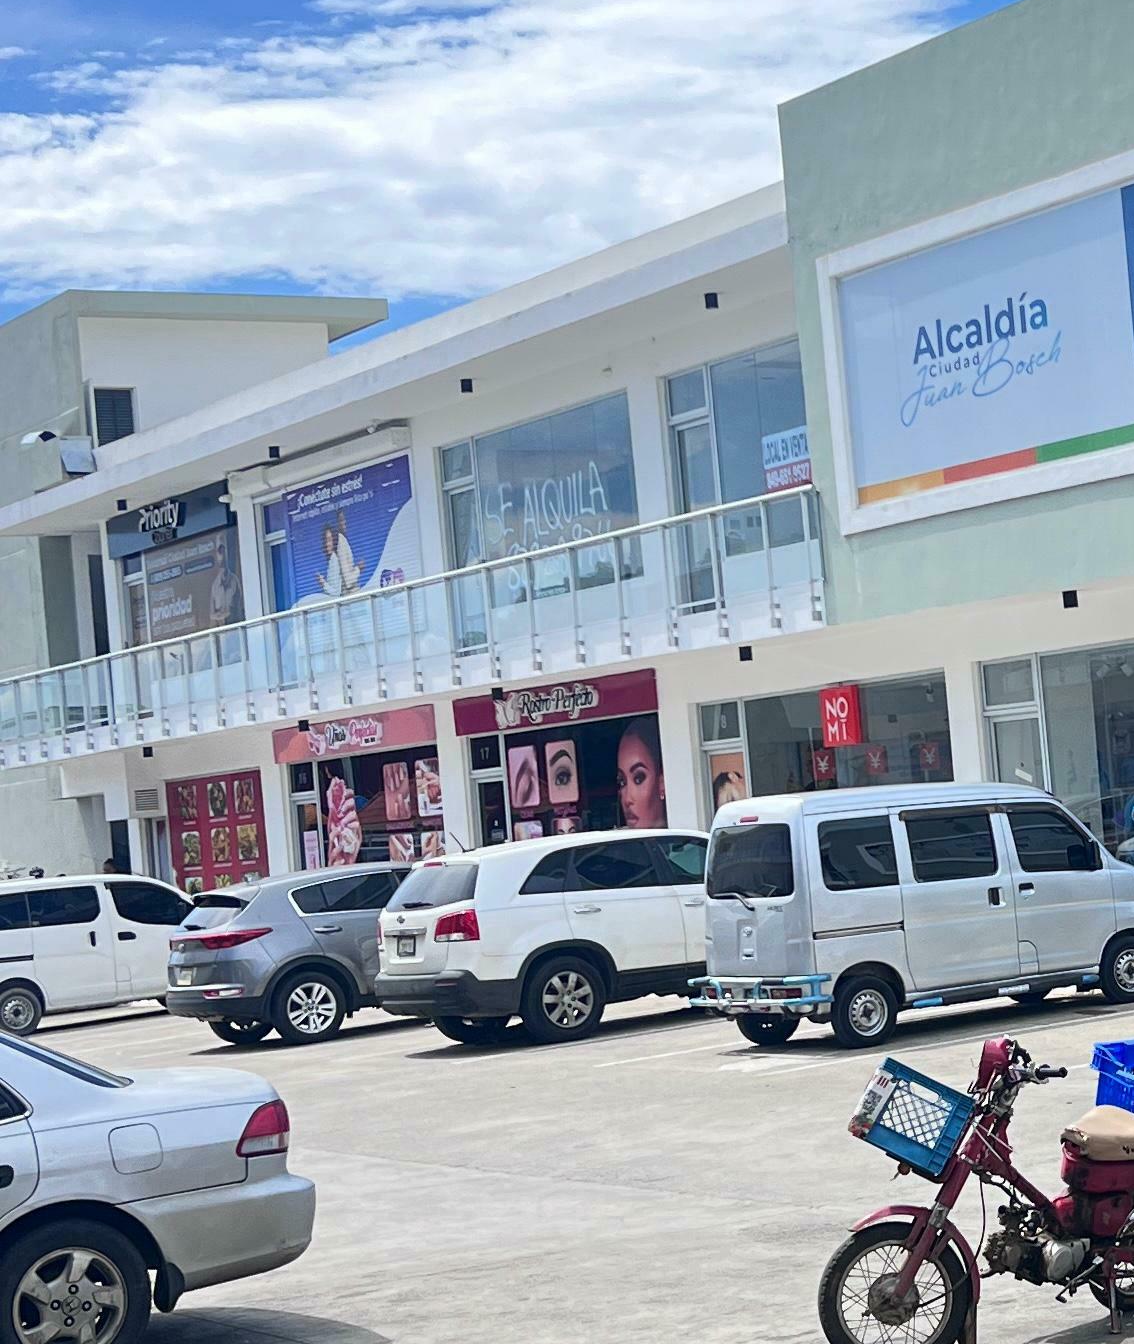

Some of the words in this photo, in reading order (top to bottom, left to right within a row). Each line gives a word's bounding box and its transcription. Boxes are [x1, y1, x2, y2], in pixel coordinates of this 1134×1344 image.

[913, 290, 1048, 365] Alcaldía
[900, 364, 967, 428] Juan
[971, 329, 1062, 397] Bosch
[928, 351, 981, 378] Ciudad
[138, 500, 180, 533] Priority
[484, 481, 515, 545] SE
[522, 460, 609, 548] ALQUILA
[825, 696, 849, 721] NO
[480, 747, 490, 761] 17
